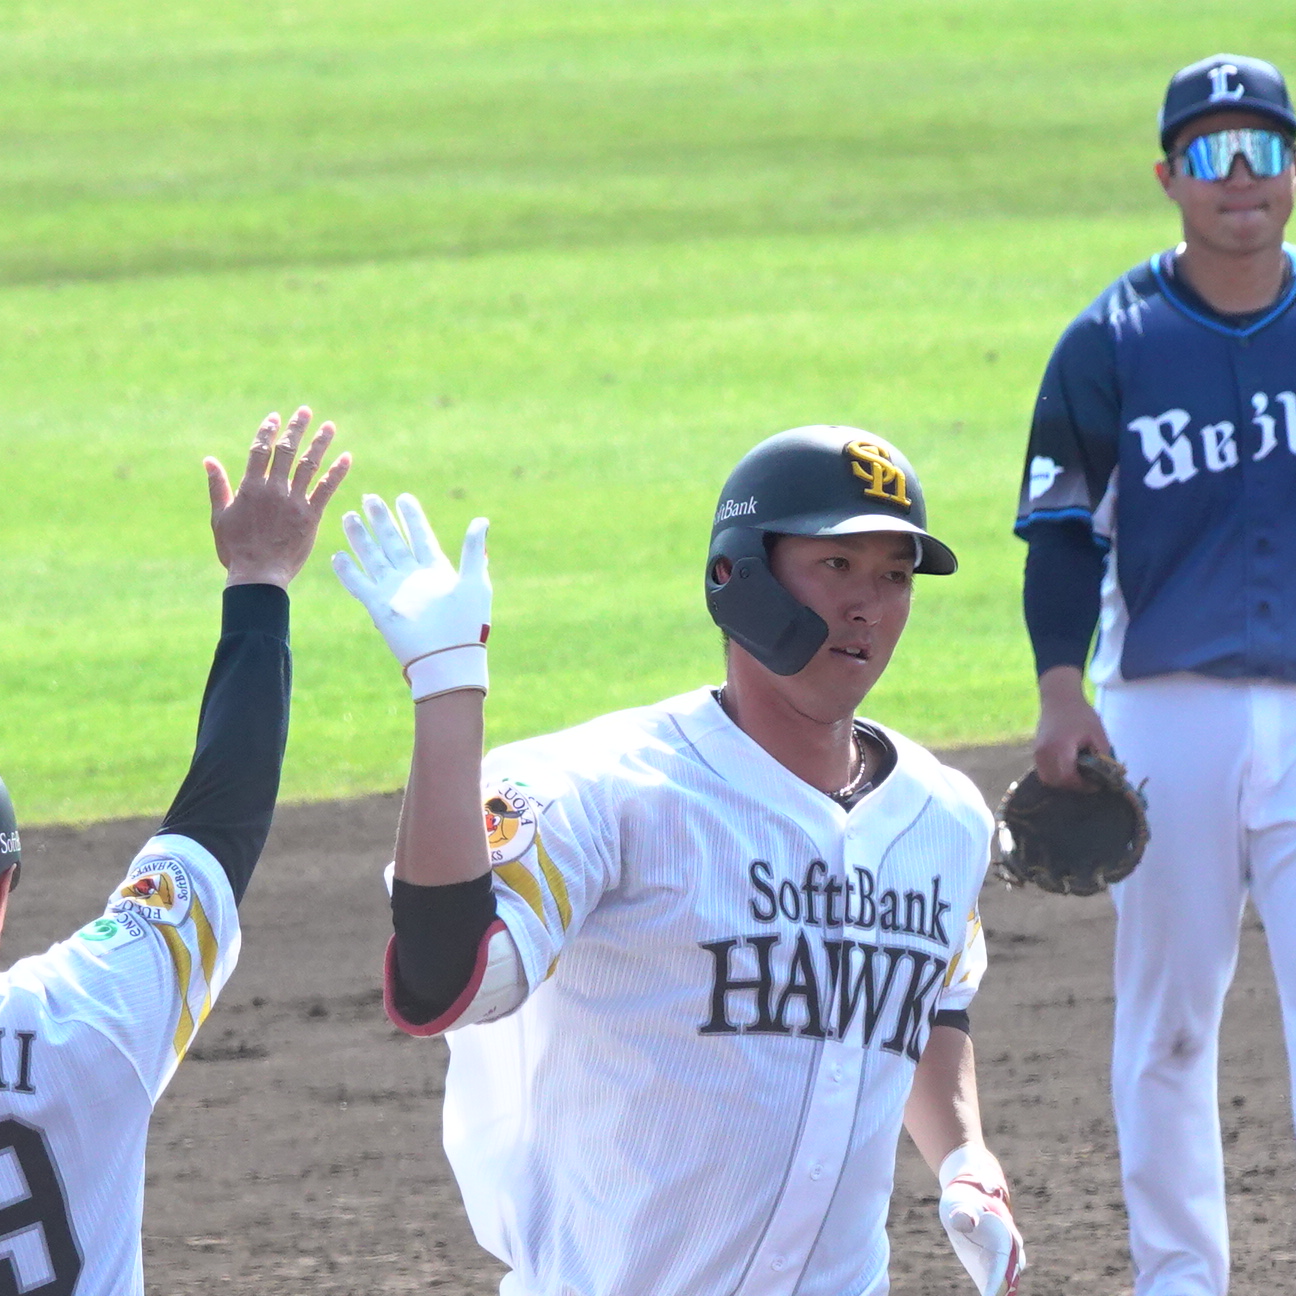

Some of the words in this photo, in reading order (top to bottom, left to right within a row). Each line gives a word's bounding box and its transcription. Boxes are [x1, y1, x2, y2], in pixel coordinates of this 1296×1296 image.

[1207, 64, 1244, 102] L
[748, 857, 952, 948] SoftBank
[697, 927, 948, 1064] HAWK
